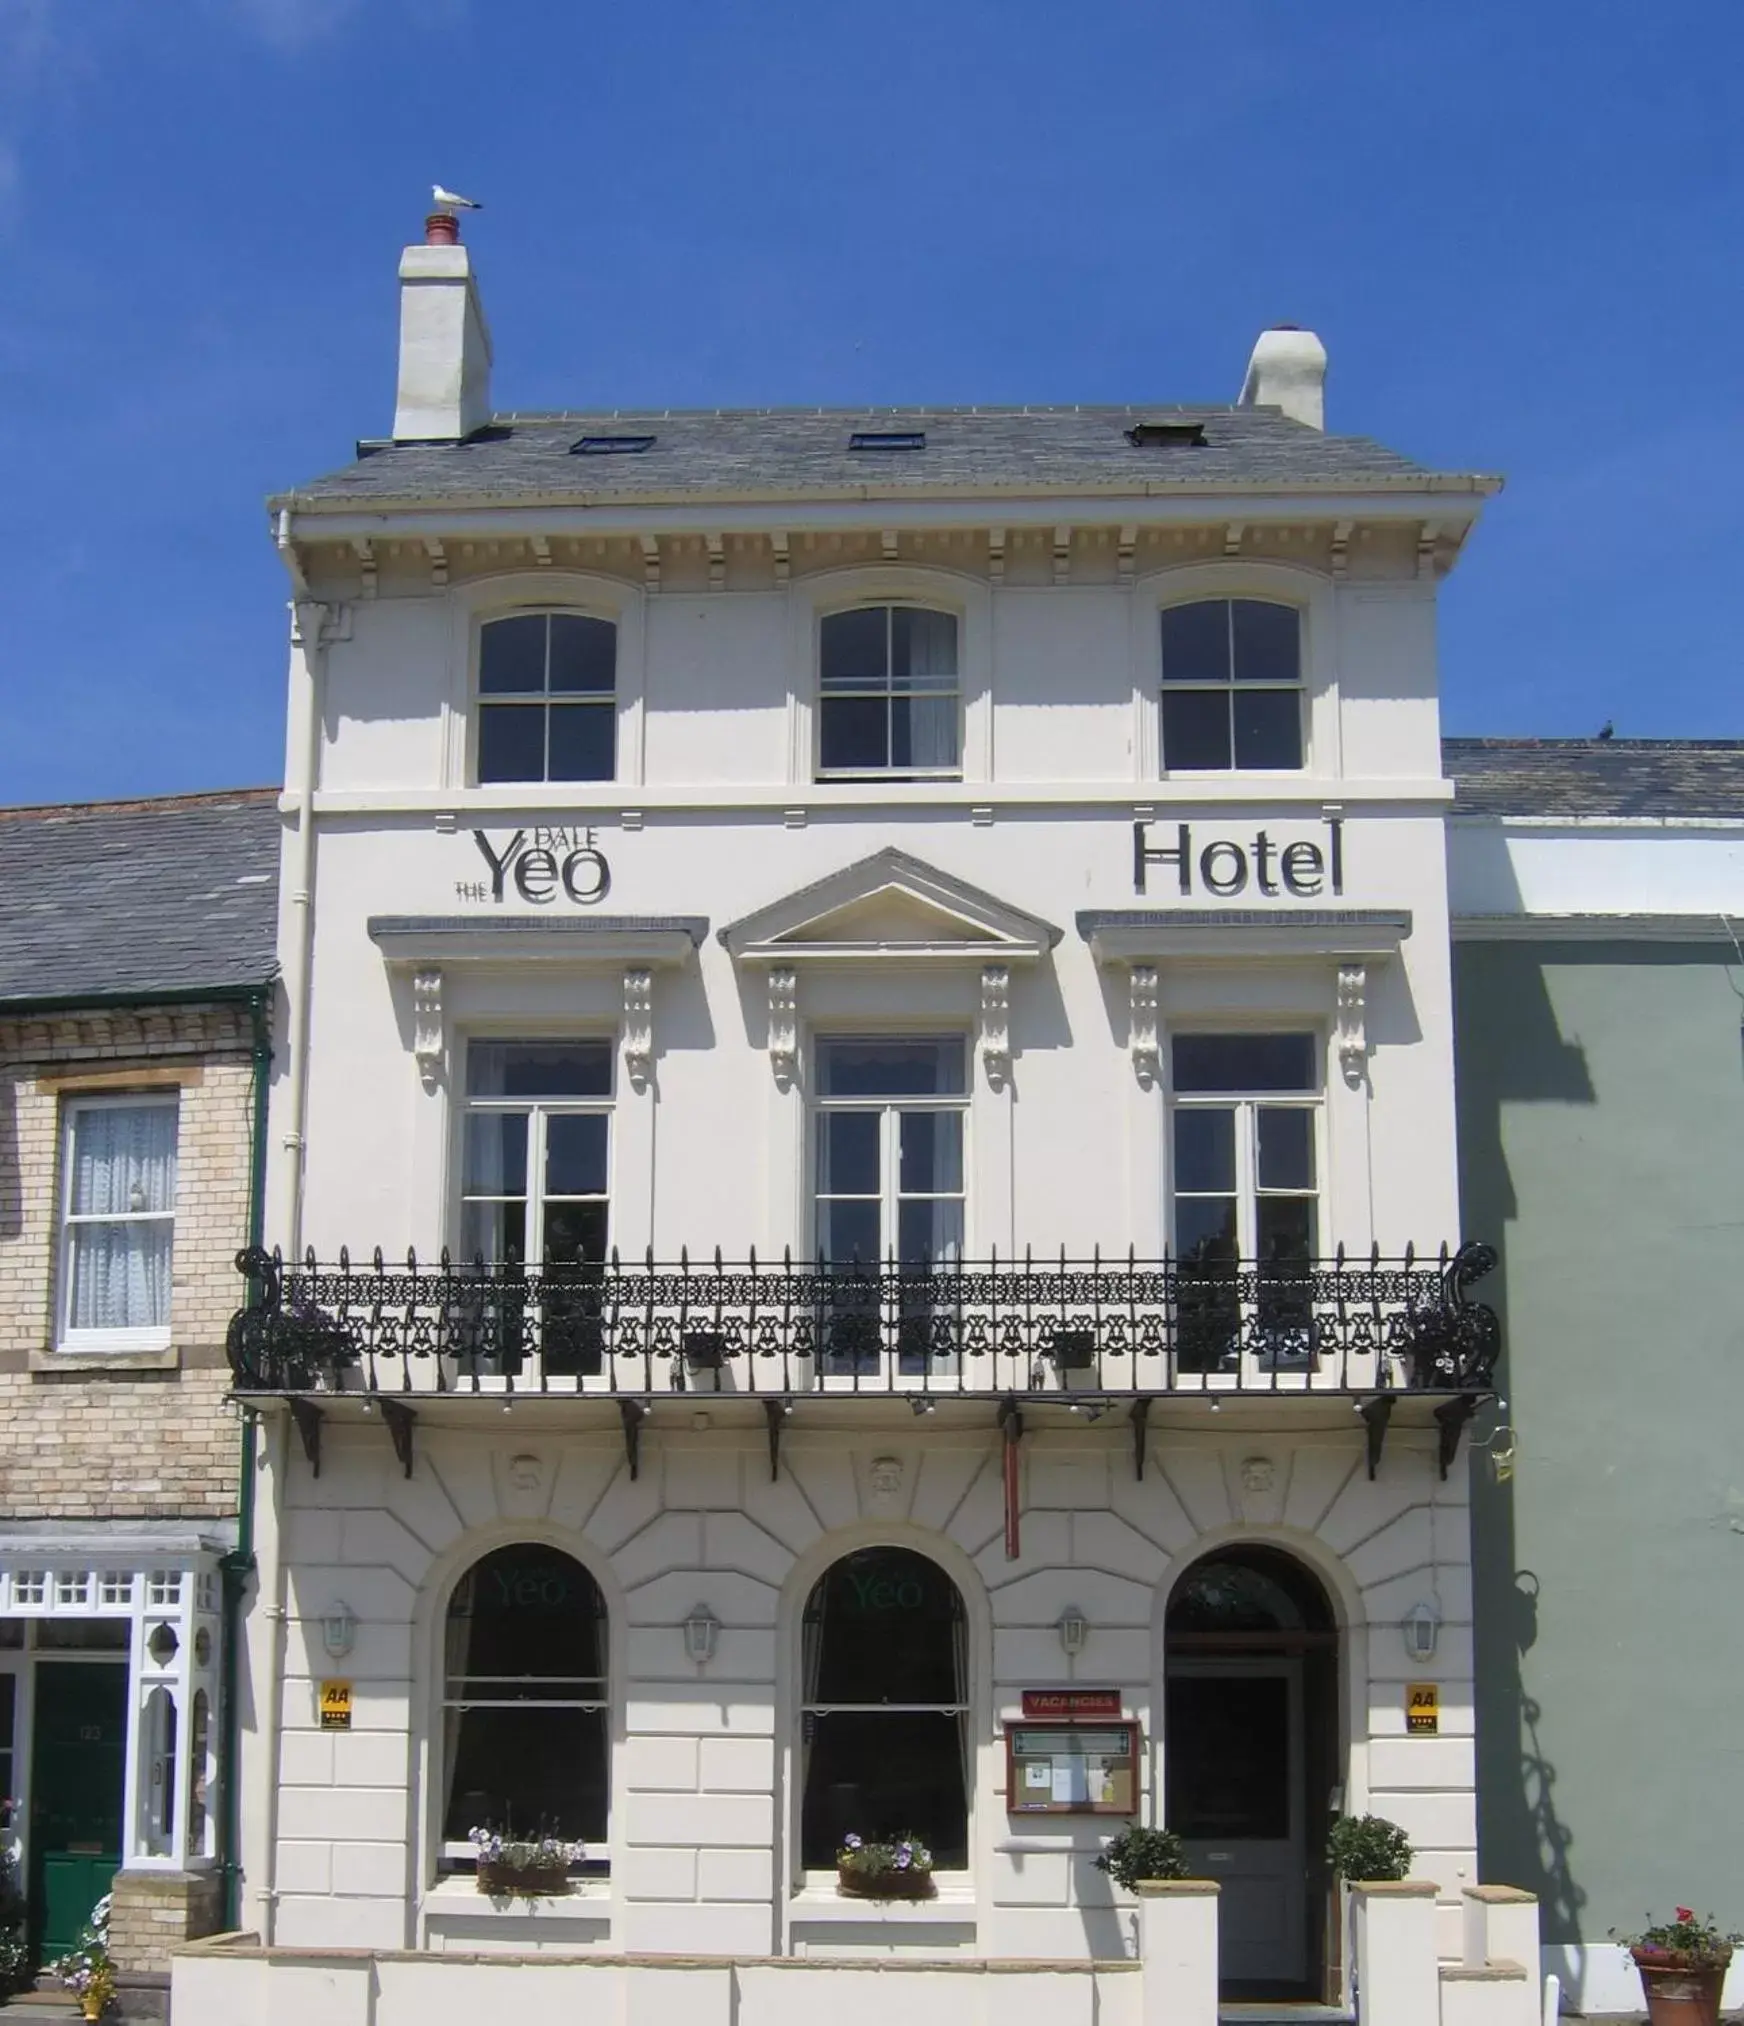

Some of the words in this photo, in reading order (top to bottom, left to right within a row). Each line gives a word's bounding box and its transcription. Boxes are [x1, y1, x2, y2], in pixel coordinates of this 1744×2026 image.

[534, 825, 599, 847] DALE
[454, 881, 488, 899] THE
[473, 829, 611, 900] Yeo
[1133, 819, 1343, 892] Hotel
[493, 1569, 566, 1606] Yeo
[849, 1573, 922, 1609] Yeo
[324, 1688, 349, 1704] AA
[1411, 1692, 1434, 1708] AA
